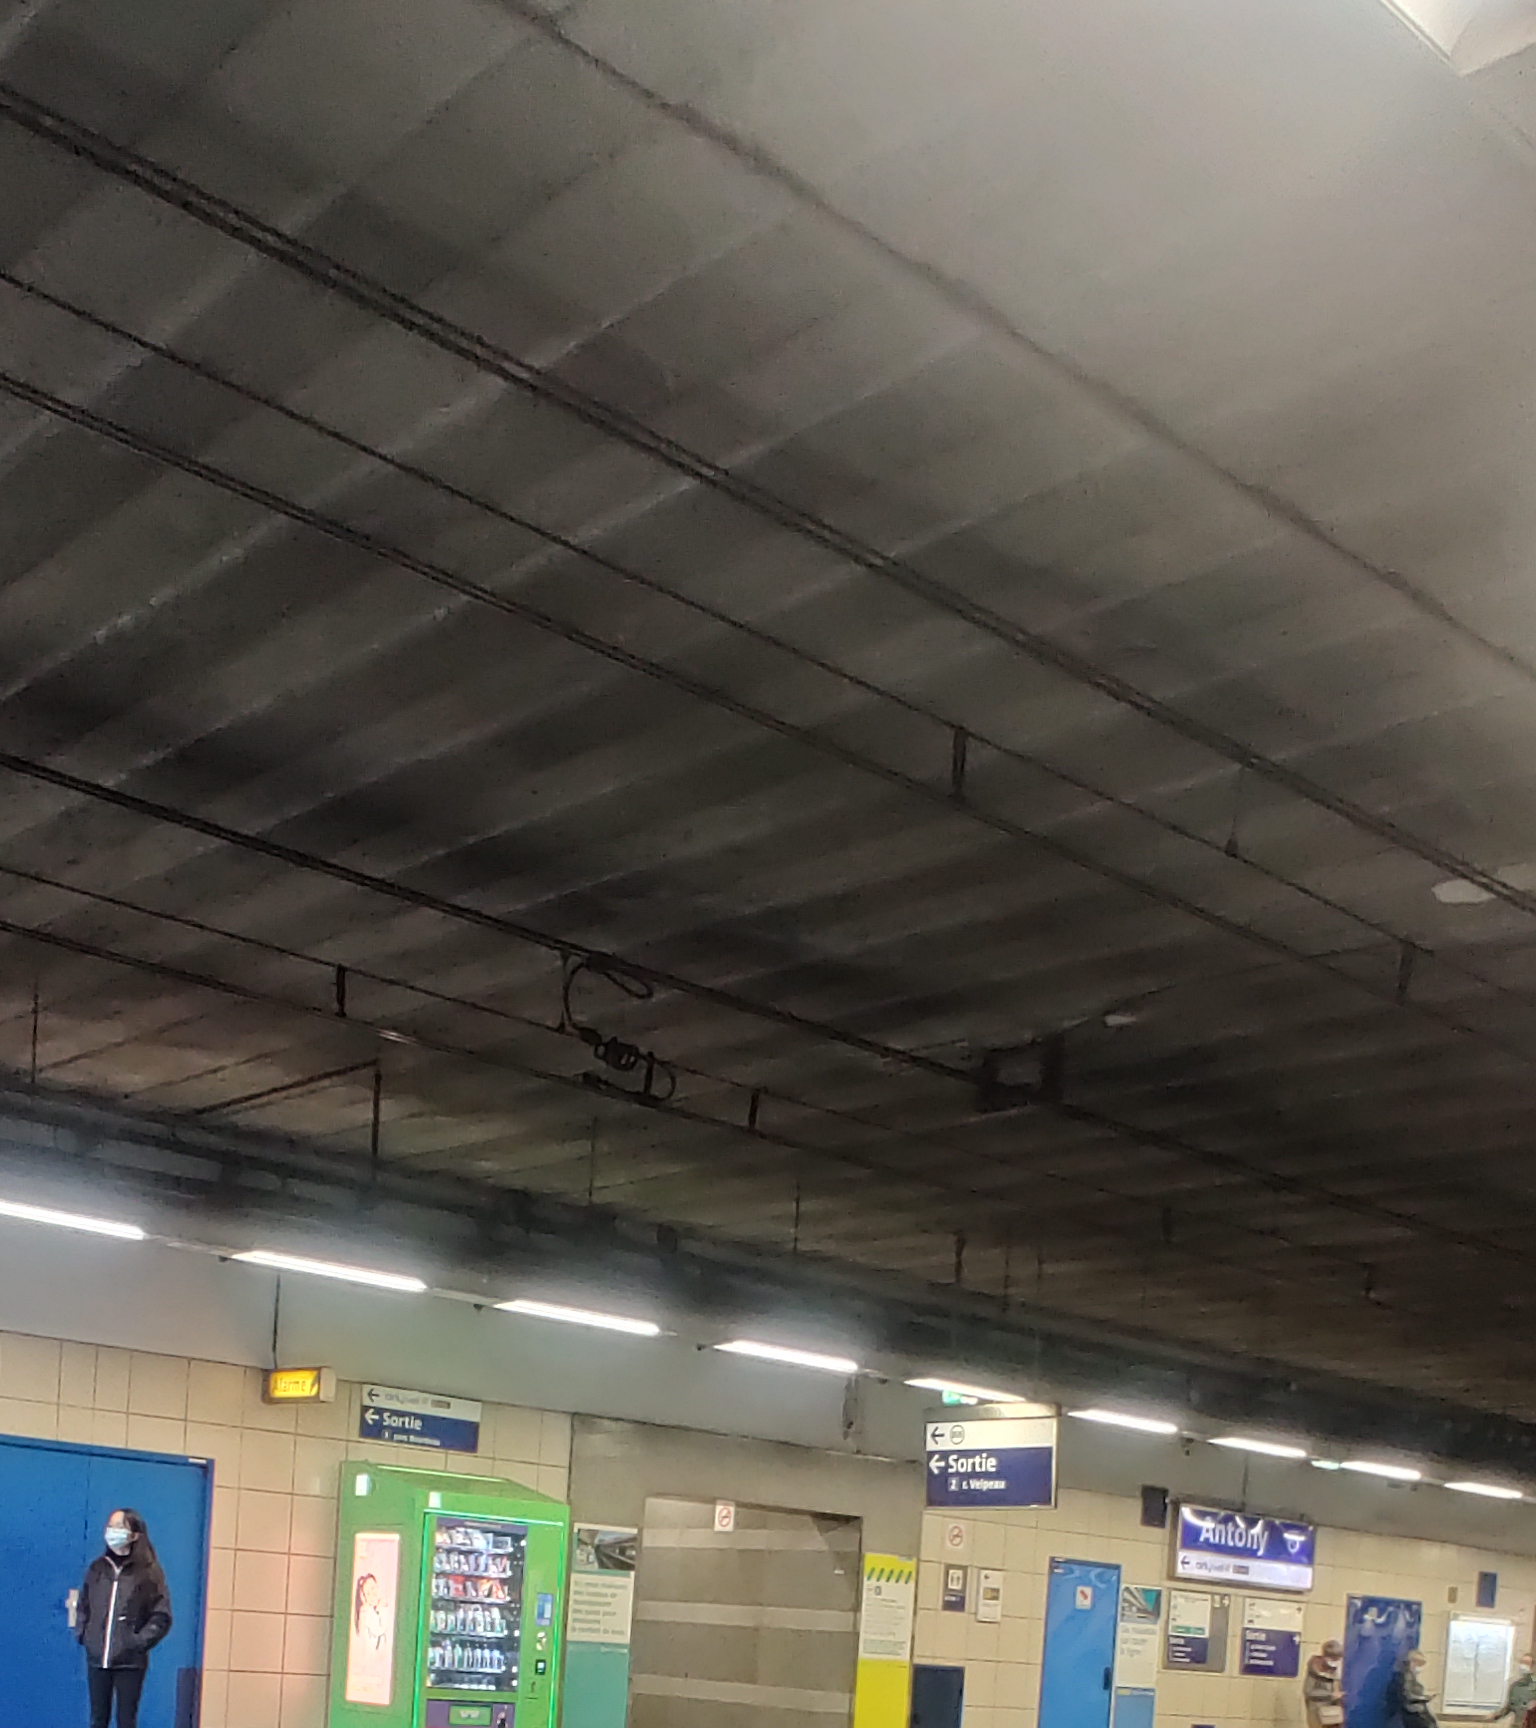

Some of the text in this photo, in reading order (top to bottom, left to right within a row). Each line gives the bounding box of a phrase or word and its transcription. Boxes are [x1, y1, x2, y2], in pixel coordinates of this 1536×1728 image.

[271, 1378, 307, 1394] Alarme
[382, 1411, 423, 1431] Sortie
[947, 1453, 998, 1473] Sortie
[1199, 1518, 1269, 1557] Antony
